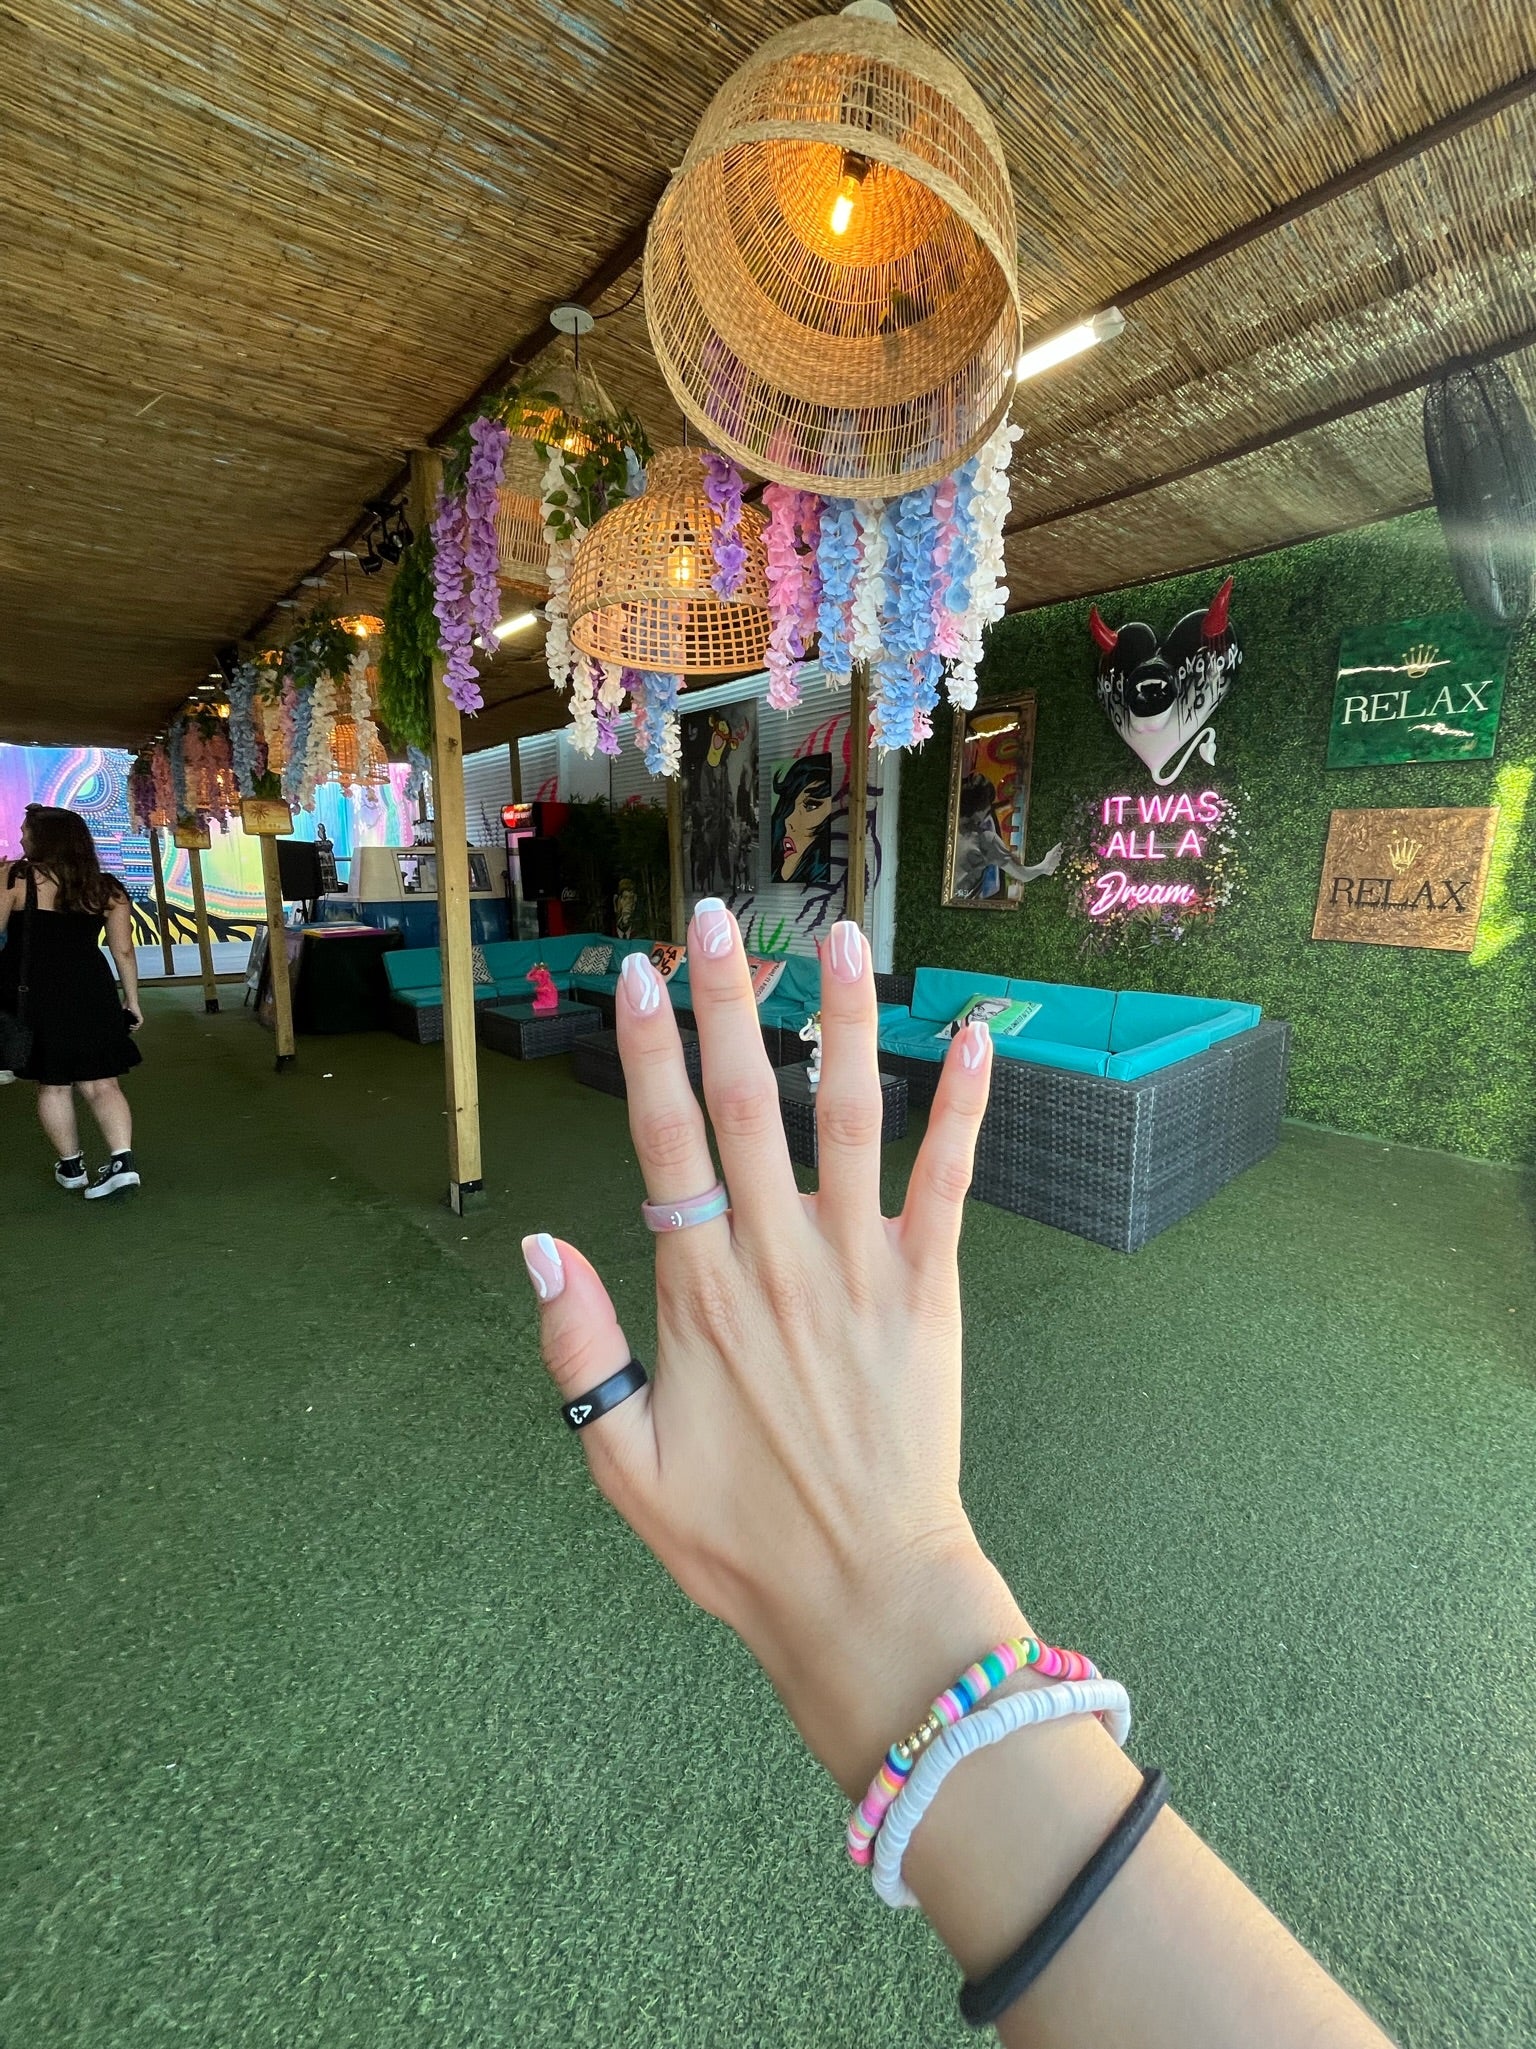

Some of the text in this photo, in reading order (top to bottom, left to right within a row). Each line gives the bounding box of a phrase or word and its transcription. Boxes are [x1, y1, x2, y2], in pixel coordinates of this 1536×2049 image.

[1341, 680, 1494, 725] RELAX
[1103, 791, 1220, 825] IT WAS
[1105, 828, 1202, 858] ALL A
[1089, 871, 1195, 915] Dream
[1329, 877, 1470, 913] RELAX
